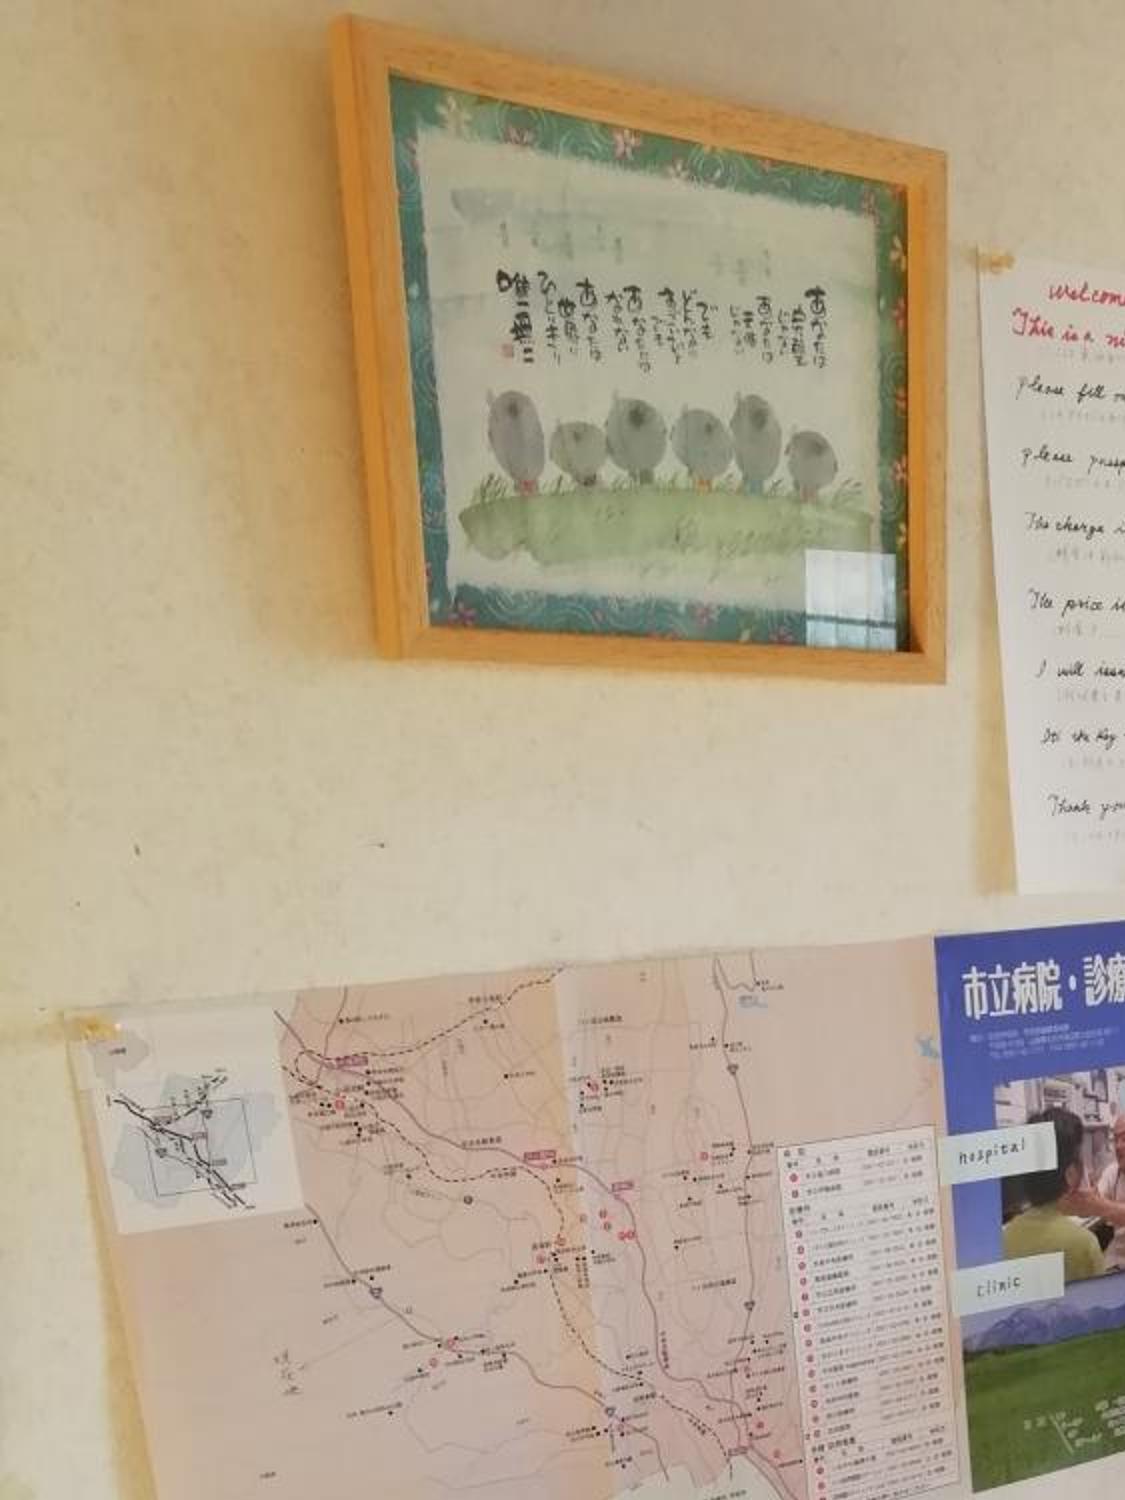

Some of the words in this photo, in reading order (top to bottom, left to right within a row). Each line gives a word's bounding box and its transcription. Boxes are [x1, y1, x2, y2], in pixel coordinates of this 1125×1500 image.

[1012, 307, 1054, 338] This
[1077, 383, 1104, 404] fill
[1056, 516, 1104, 541] charge
[1061, 595, 1103, 618] price
[1057, 660, 1084, 677] will
[1047, 792, 1092, 817] Thank
[958, 1138, 1026, 1165] hospital
[976, 1274, 1021, 1297] clinic
